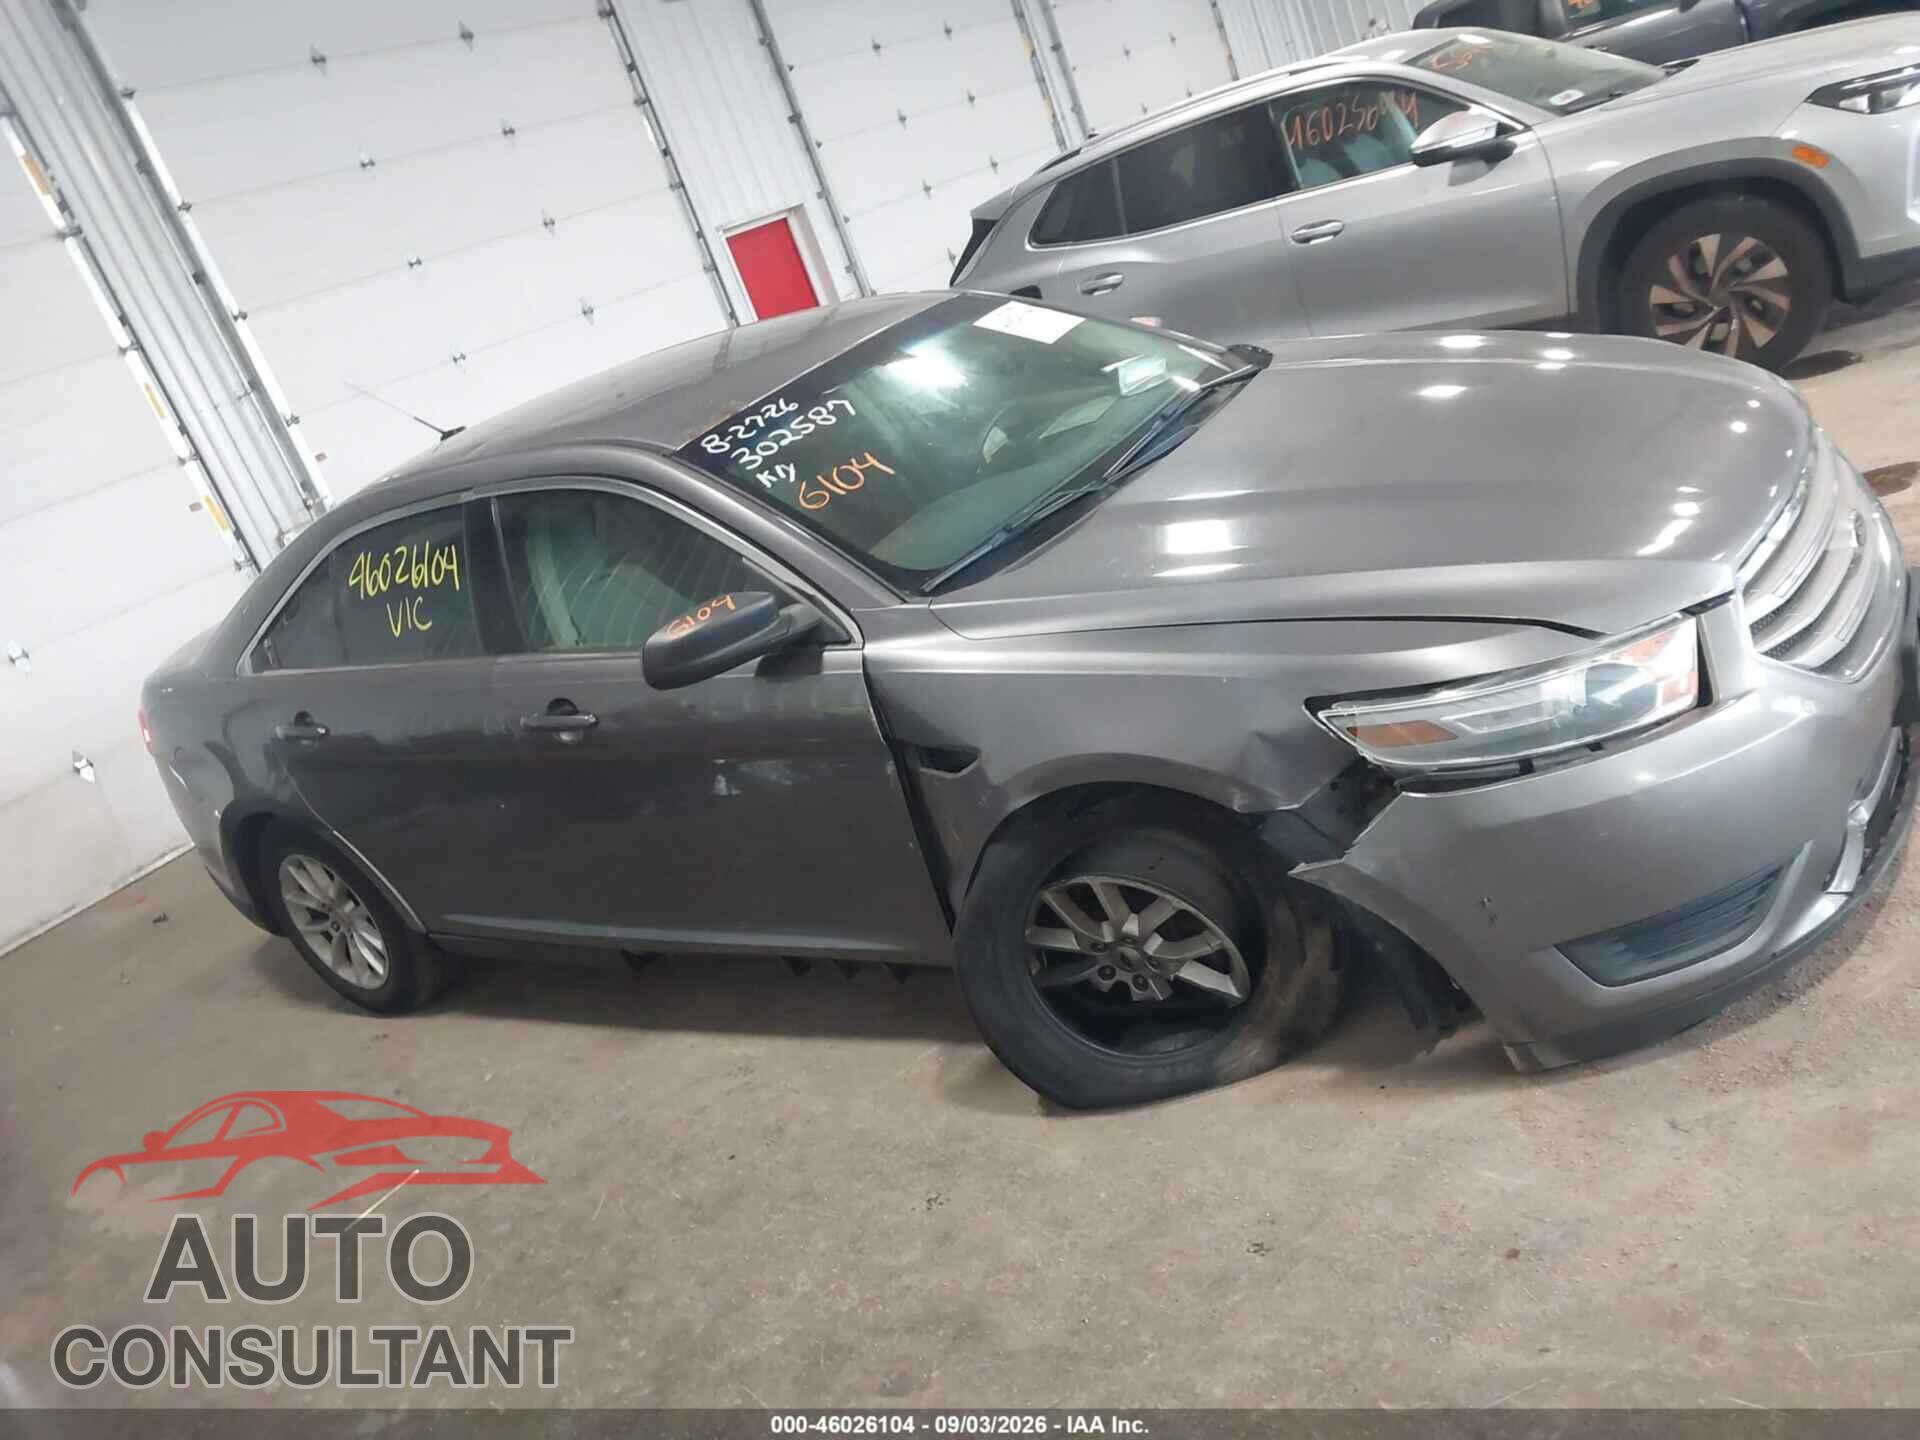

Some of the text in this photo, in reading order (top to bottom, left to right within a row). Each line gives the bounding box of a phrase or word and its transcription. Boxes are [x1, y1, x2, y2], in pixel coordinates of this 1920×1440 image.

[730, 400, 856, 470] 302587
[799, 452, 895, 509] 6104
[349, 540, 460, 600] 46026104
[386, 596, 433, 638] VIC
